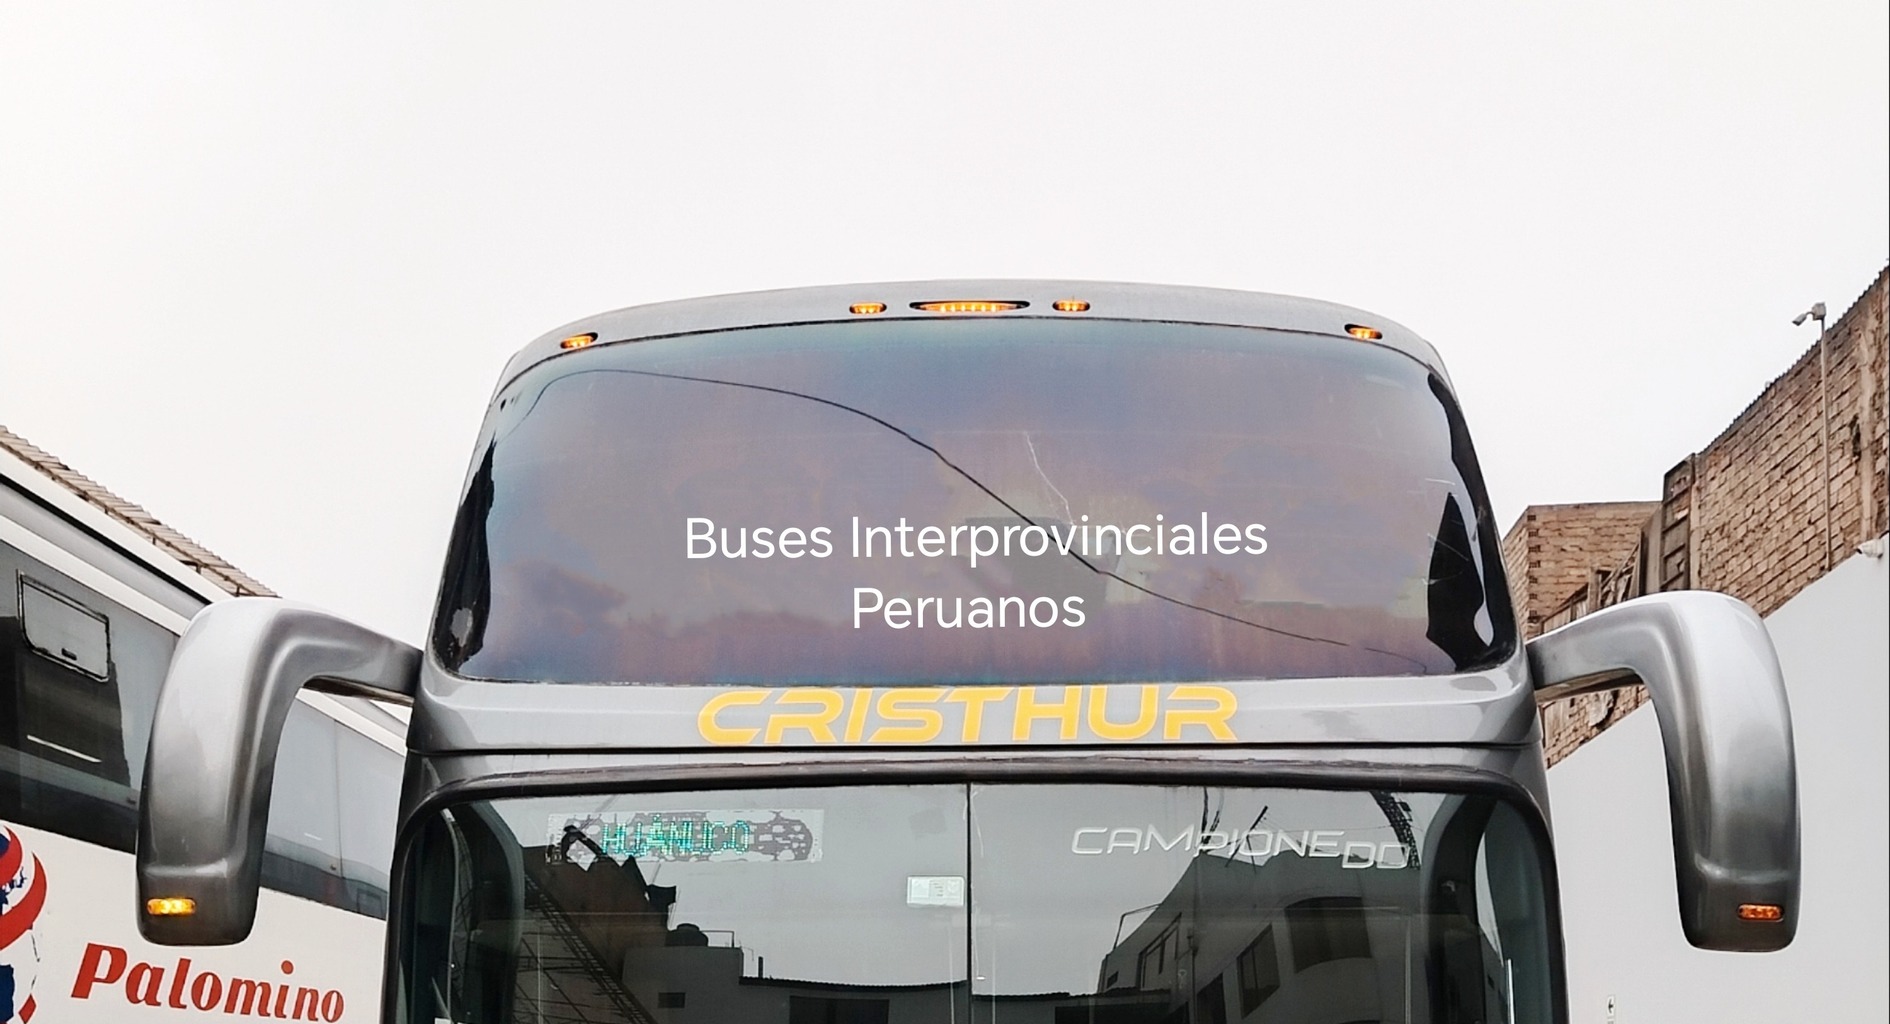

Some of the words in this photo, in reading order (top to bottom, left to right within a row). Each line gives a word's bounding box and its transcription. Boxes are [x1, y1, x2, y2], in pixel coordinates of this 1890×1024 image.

[696, 684, 1239, 746] CRISTHUR
[1071, 824, 1345, 858] CAMPIONE
[71, 942, 345, 1023] Palomino
